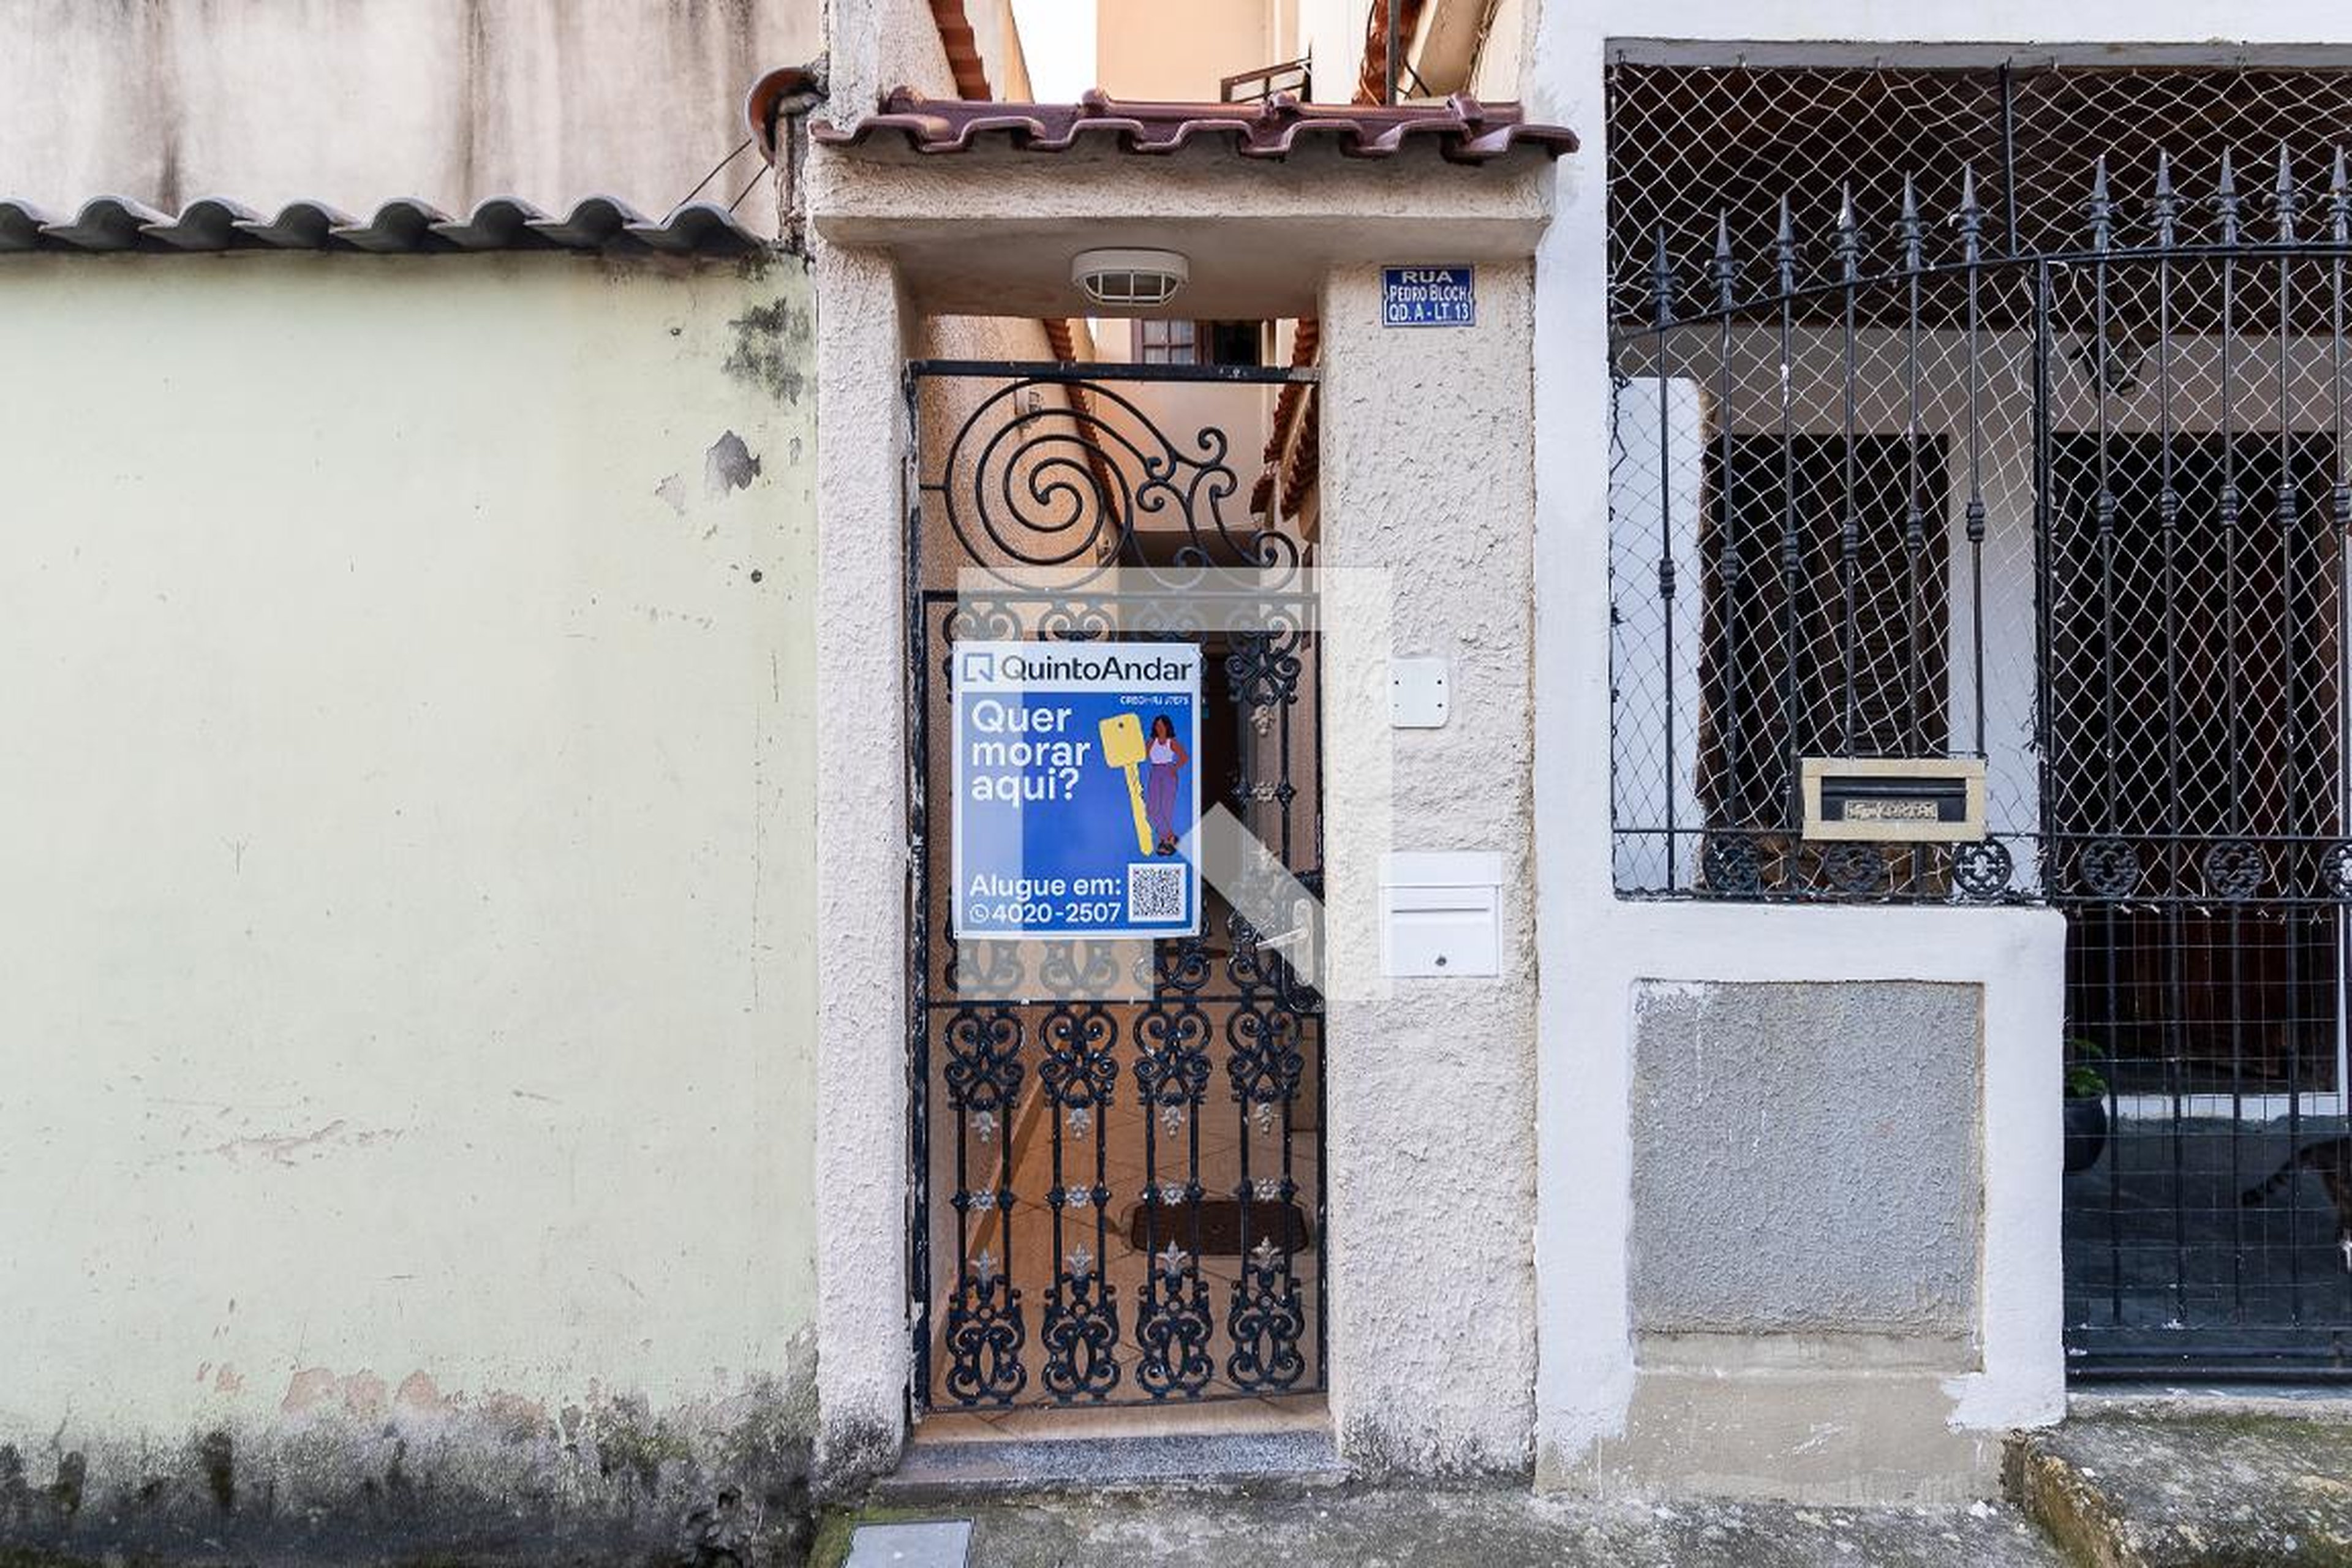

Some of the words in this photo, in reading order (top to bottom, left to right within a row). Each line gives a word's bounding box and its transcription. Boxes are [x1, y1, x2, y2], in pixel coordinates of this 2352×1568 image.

[1402, 271, 1453, 284] RUA
[1389, 285, 1428, 302] PEDRO
[1429, 284, 1467, 301] BLOCH
[1434, 303, 1450, 320] LT
[1002, 655, 1193, 681] QuintoAndar
[972, 700, 1072, 733] Quer
[973, 741, 1091, 767] morar
[971, 769, 1079, 808] aqui?
[970, 876, 1066, 902] Alugue
[1073, 878, 1122, 896] em:
[992, 903, 1121, 923] 4020-2507
